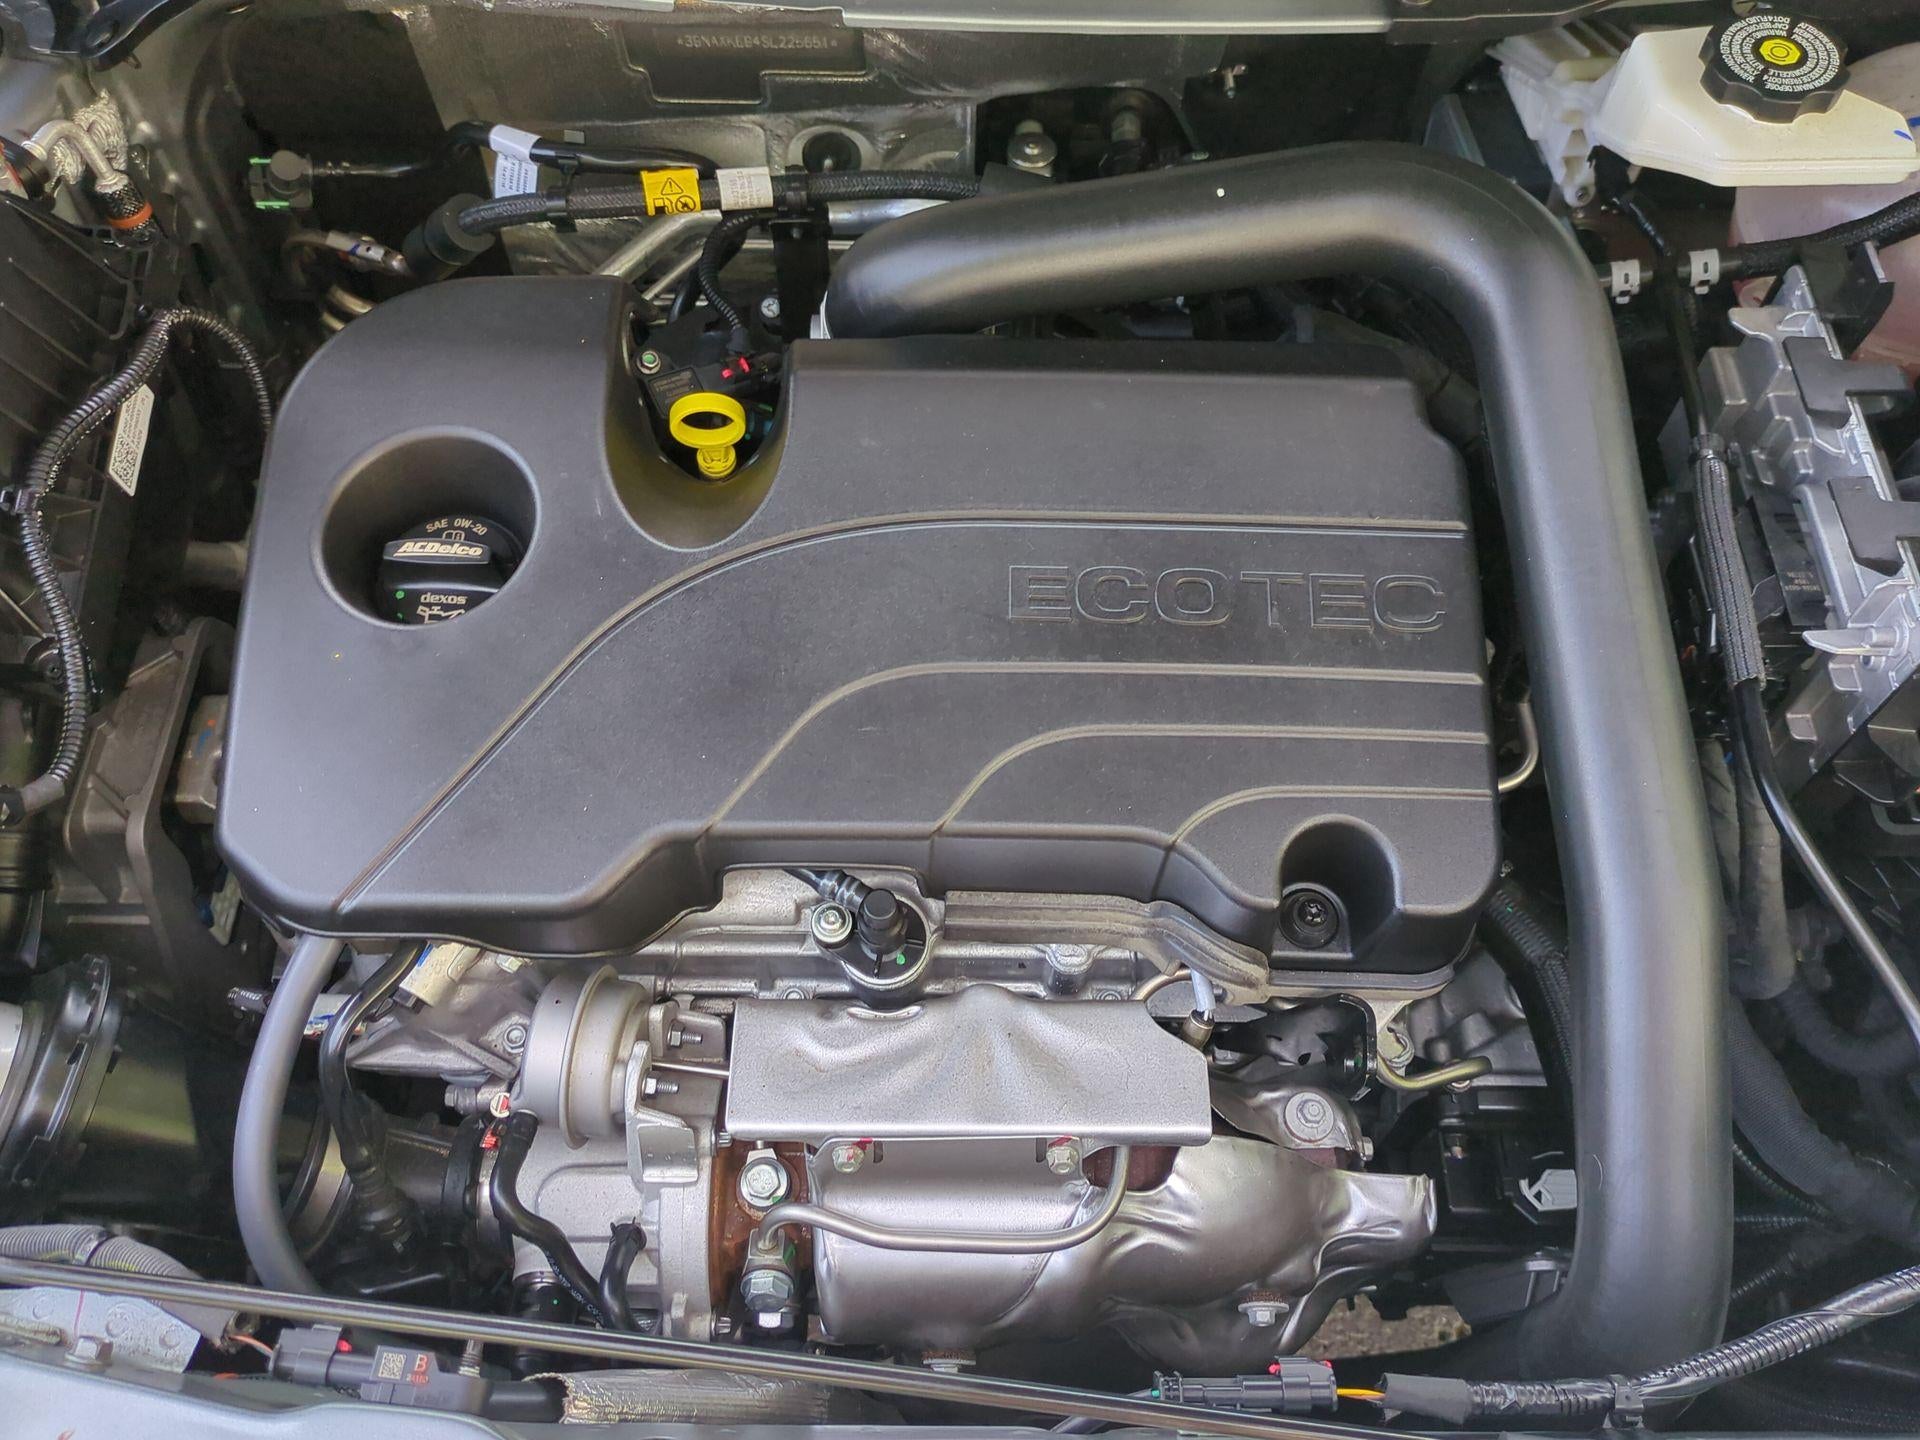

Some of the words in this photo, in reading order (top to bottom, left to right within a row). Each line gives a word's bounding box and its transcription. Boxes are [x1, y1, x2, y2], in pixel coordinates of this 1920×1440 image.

[1743, 15, 1768, 24] FLUID
[1770, 21, 1789, 30] CAP
[1772, 15, 1791, 24] DOT
[1719, 33, 1732, 53] SEALED
[1732, 53, 1747, 64] USE
[1766, 75, 1782, 84] DOT
[425, 518, 449, 533] SAE
[453, 517, 489, 536] 0W-20
[395, 541, 483, 556] ACDelco
[420, 592, 467, 605] dexos
[1008, 564, 1447, 634] ECOTEC
[414, 1353, 428, 1372] B
